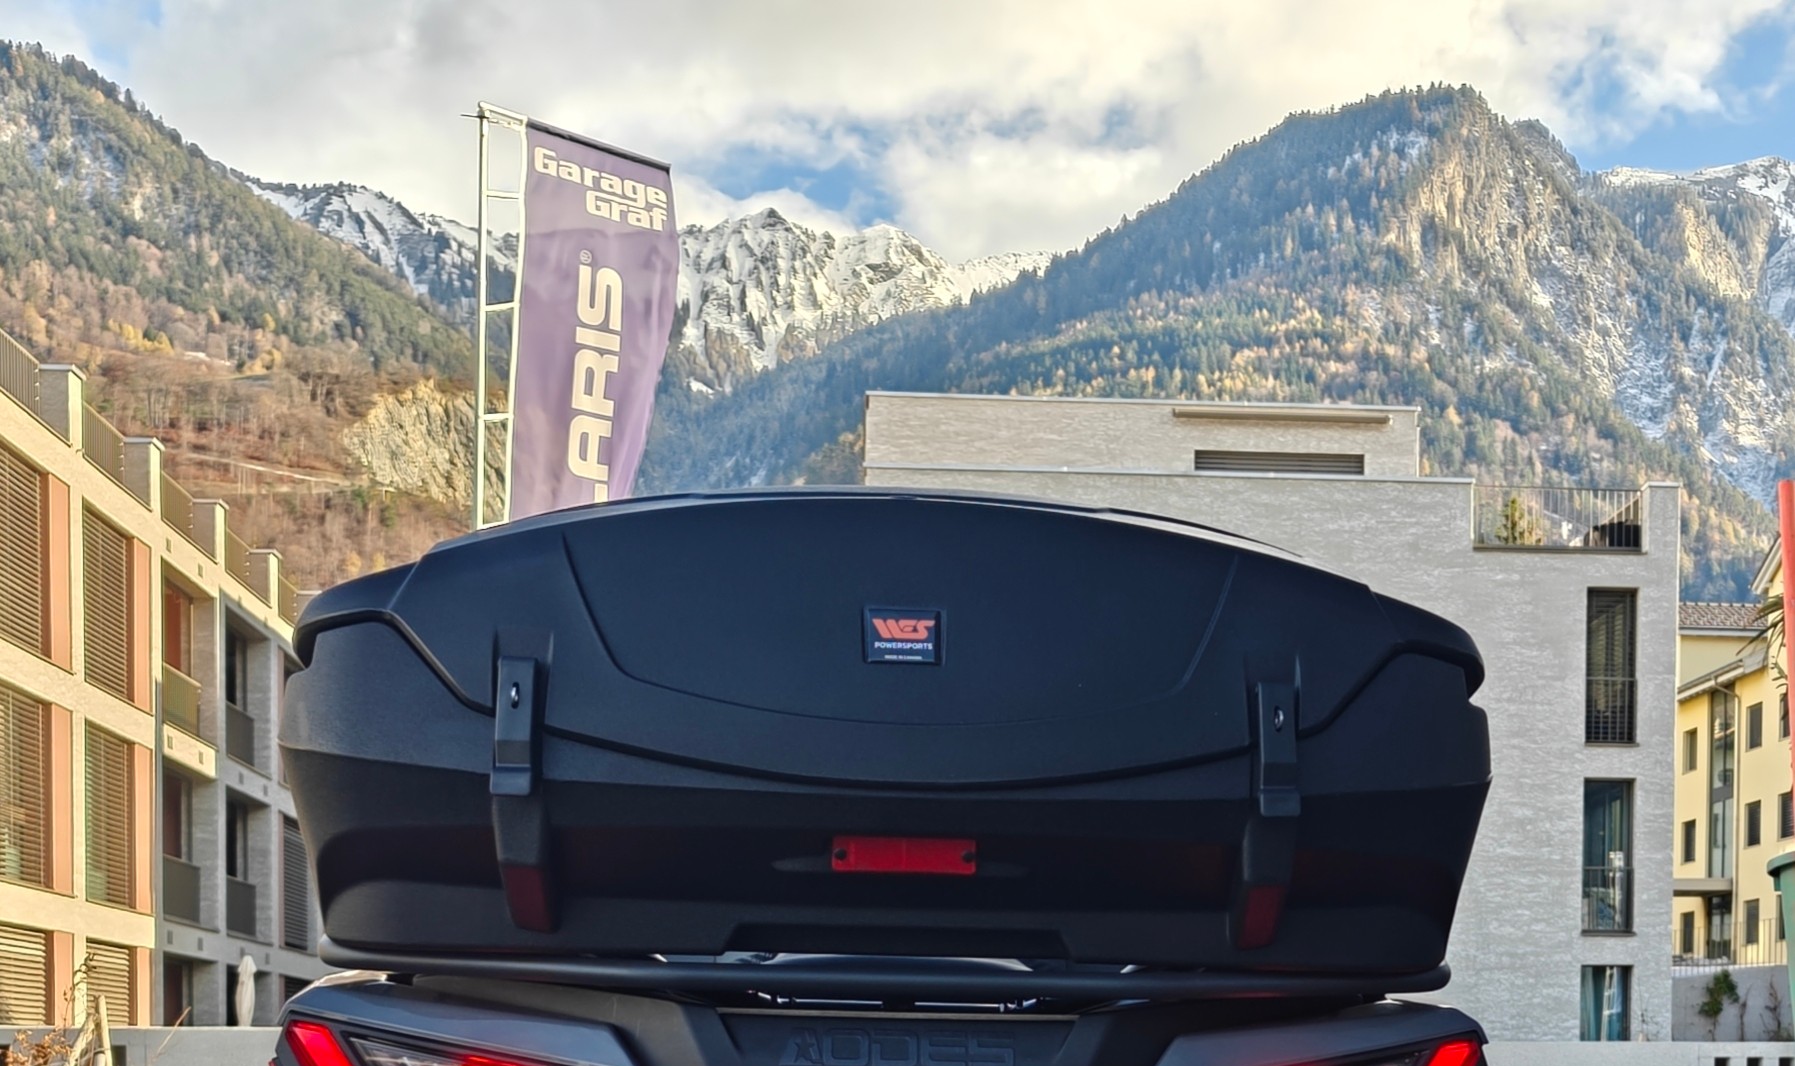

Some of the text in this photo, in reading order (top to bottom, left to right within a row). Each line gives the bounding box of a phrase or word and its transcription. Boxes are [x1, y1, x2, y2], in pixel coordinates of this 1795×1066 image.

[534, 146, 668, 208] Garage
[586, 190, 668, 232] Graf
[874, 641, 933, 650] POWERSPORTS
